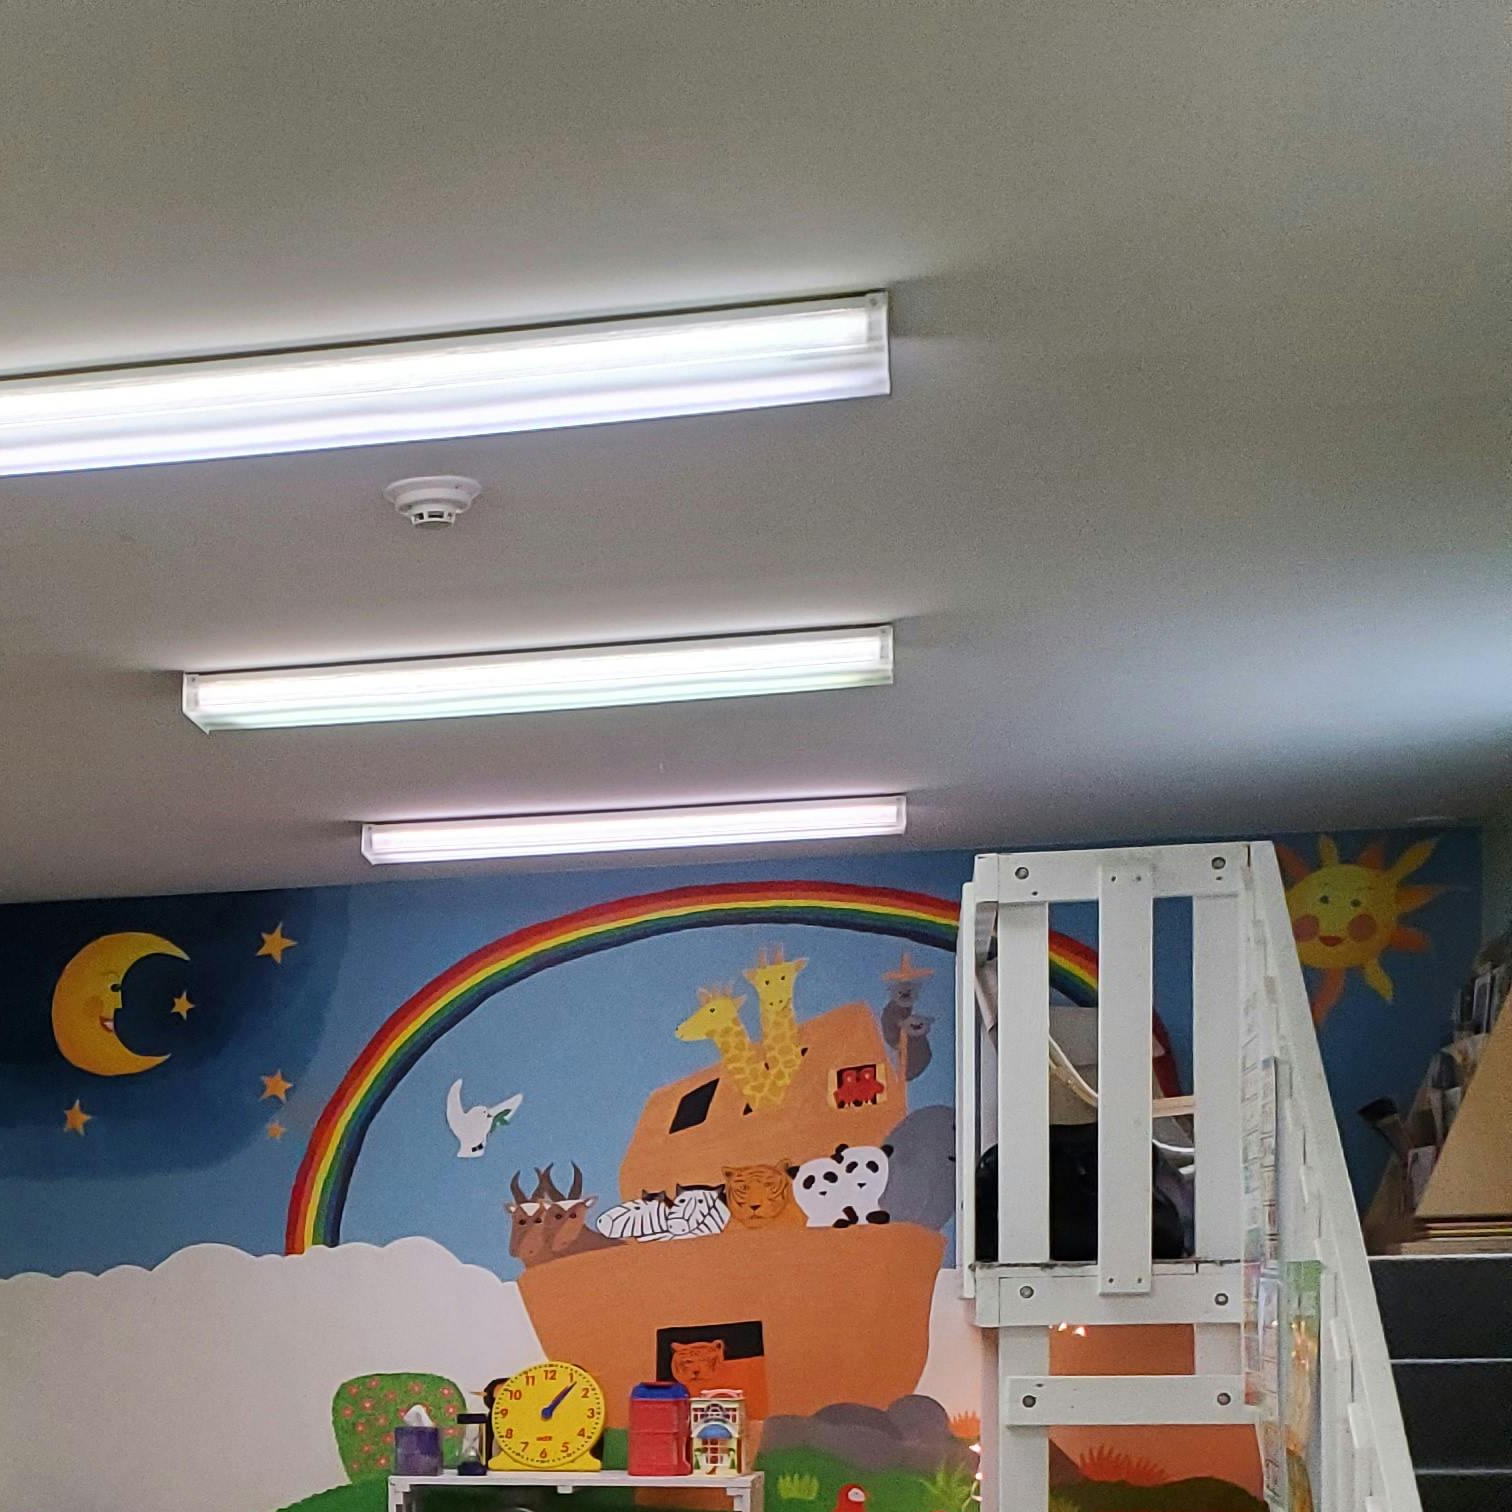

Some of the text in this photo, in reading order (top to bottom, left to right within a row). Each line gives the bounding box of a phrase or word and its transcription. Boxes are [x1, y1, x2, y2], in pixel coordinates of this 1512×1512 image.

[543, 1370, 557, 1380] 12
[525, 1376, 535, 1386] 11
[508, 1390, 522, 1400] 10
[581, 1388, 590, 1399] 2
[500, 1408, 508, 1419] 9
[587, 1408, 595, 1419] 3
[505, 1428, 514, 1439] 8
[577, 1428, 586, 1438] 4
[520, 1442, 529, 1452] 7
[560, 1442, 569, 1453] 5
[539, 1448, 547, 1459] 6
